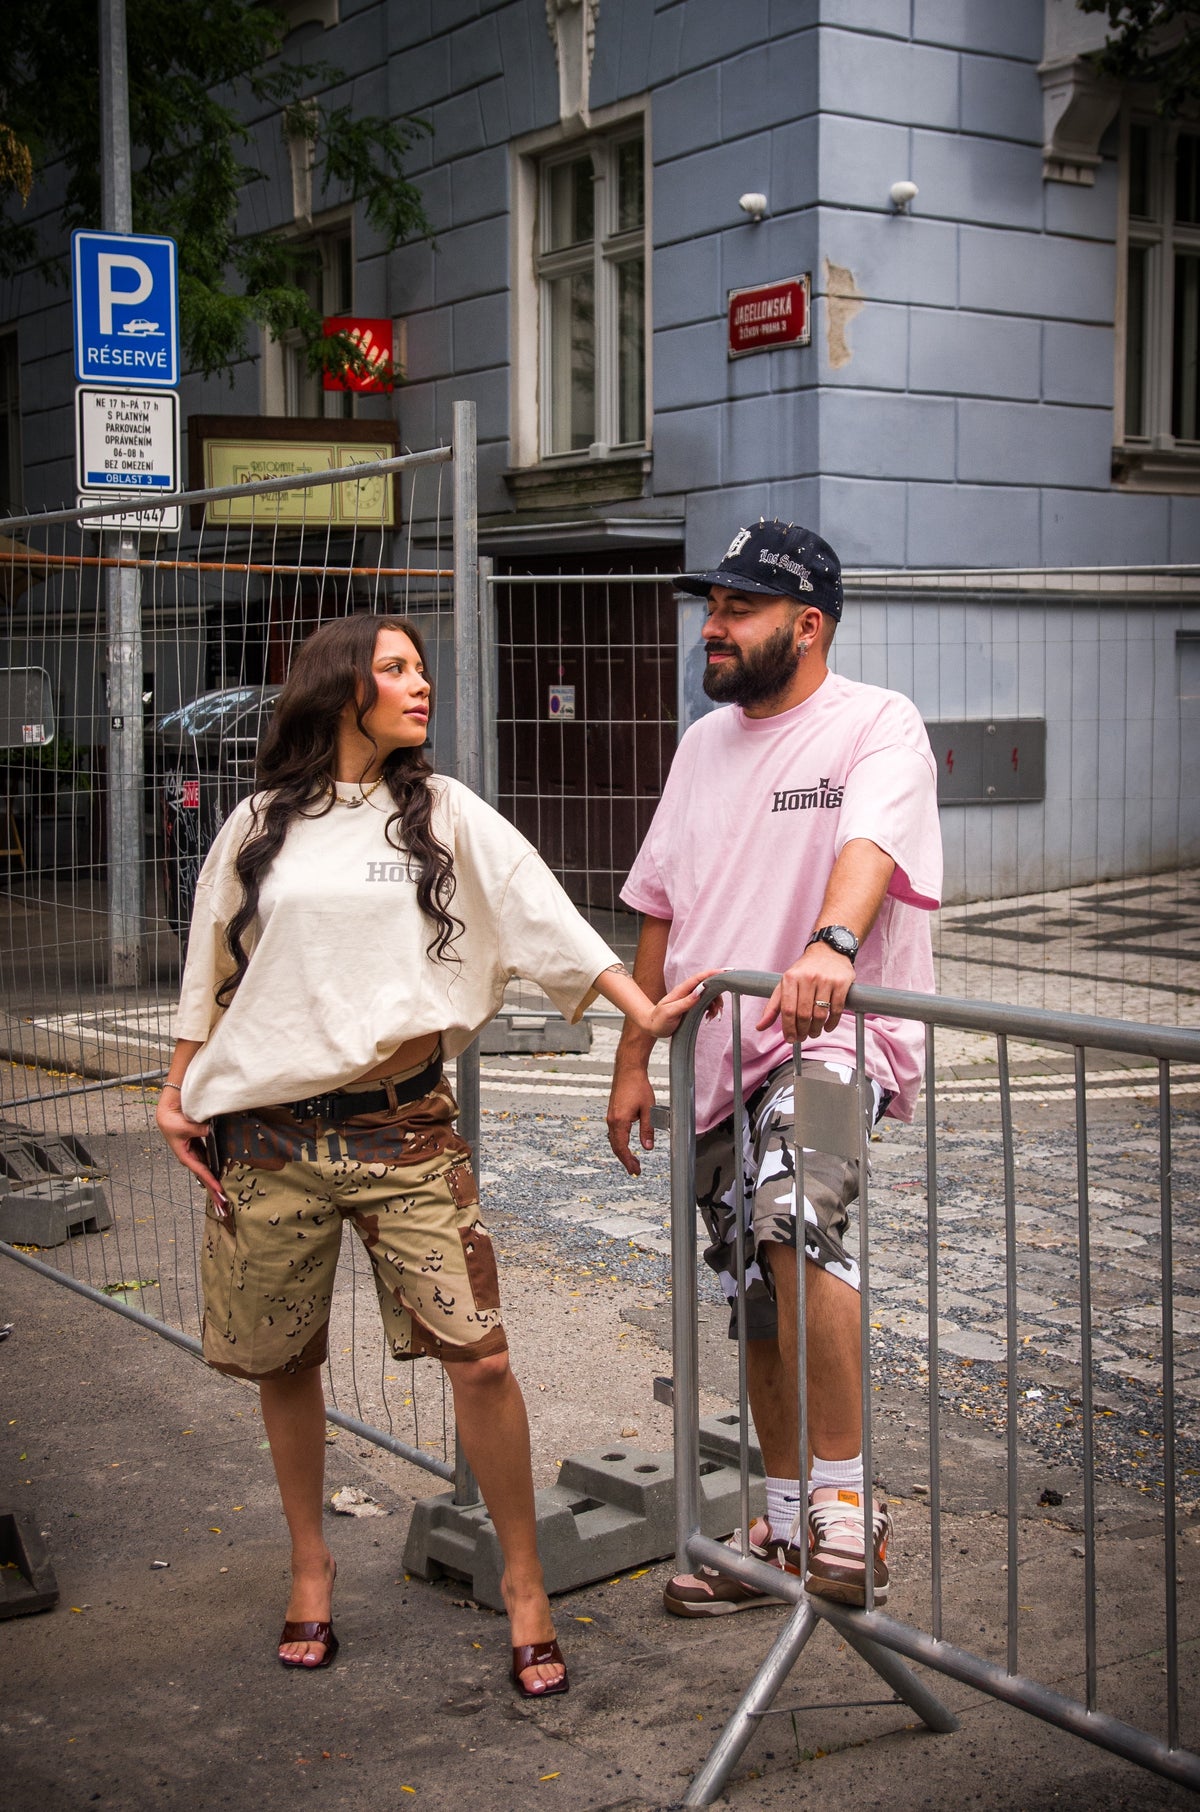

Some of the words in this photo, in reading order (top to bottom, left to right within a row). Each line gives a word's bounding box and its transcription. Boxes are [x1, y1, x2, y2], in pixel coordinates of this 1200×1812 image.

[98, 252, 154, 335] P
[87, 344, 168, 368] RÉSERVÉ
[96, 398, 105, 408] NE
[109, 398, 117, 408] 17
[143, 400, 151, 410] 17
[154, 401, 159, 411] h
[107, 410, 113, 420] S
[116, 410, 150, 422] PLATNÝM
[105, 422, 152, 434] PARKOVACÍM
[113, 447, 137, 458] 06-08
[139, 449, 145, 458] h
[104, 459, 118, 469] BEZ
[121, 460, 154, 471] OMEZENÍ
[105, 473, 143, 484] OBLAST
[147, 475, 153, 484] 3
